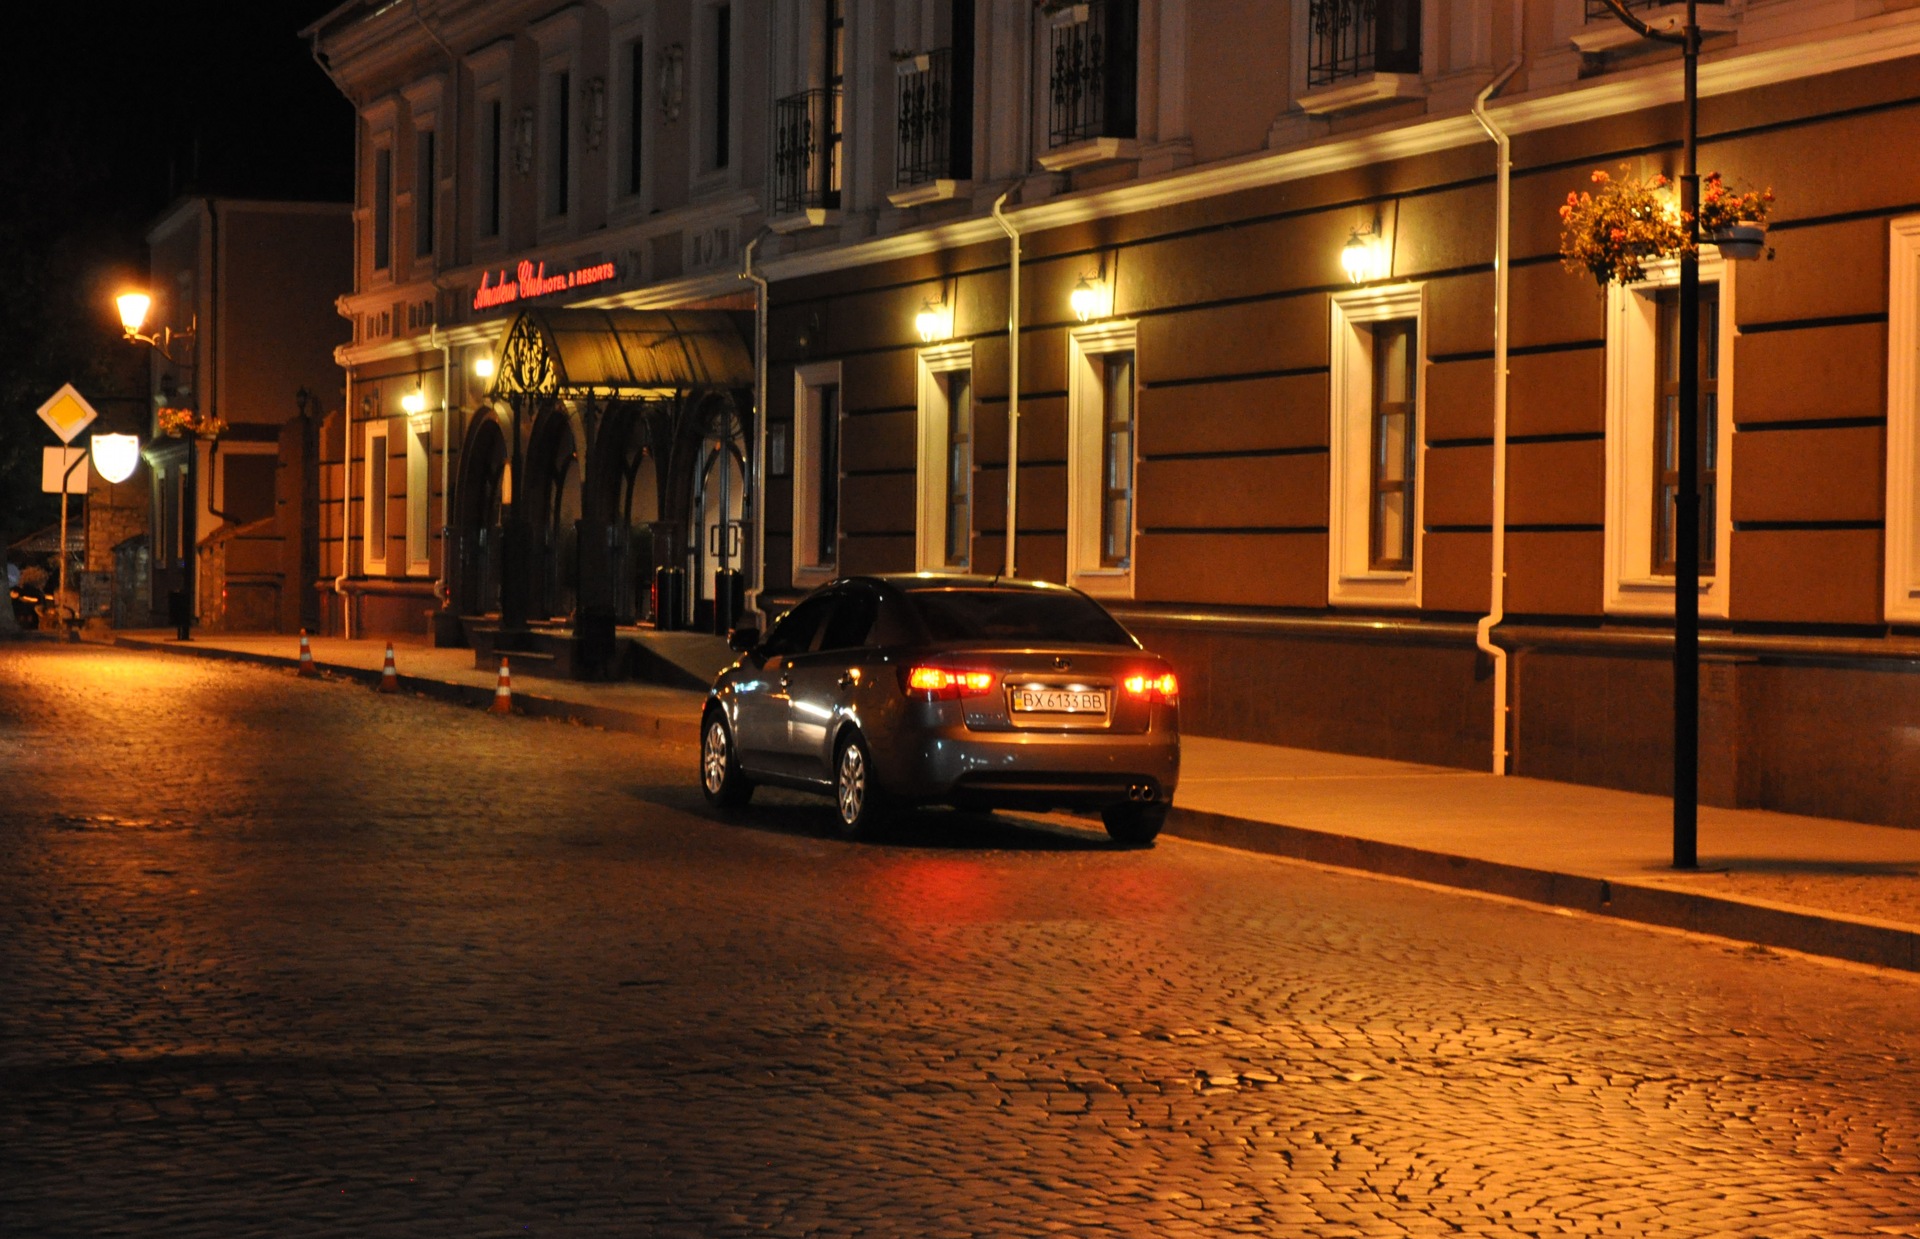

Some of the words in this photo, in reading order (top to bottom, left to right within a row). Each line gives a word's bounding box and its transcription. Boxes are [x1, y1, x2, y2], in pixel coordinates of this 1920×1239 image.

[518, 260, 545, 298] Club
[543, 275, 567, 293] HOTEL
[568, 272, 575, 287] &
[576, 263, 615, 285] RESORTS
[1023, 693, 1043, 708] BX
[1047, 694, 1079, 708] 6133
[1082, 694, 1102, 709] BB
